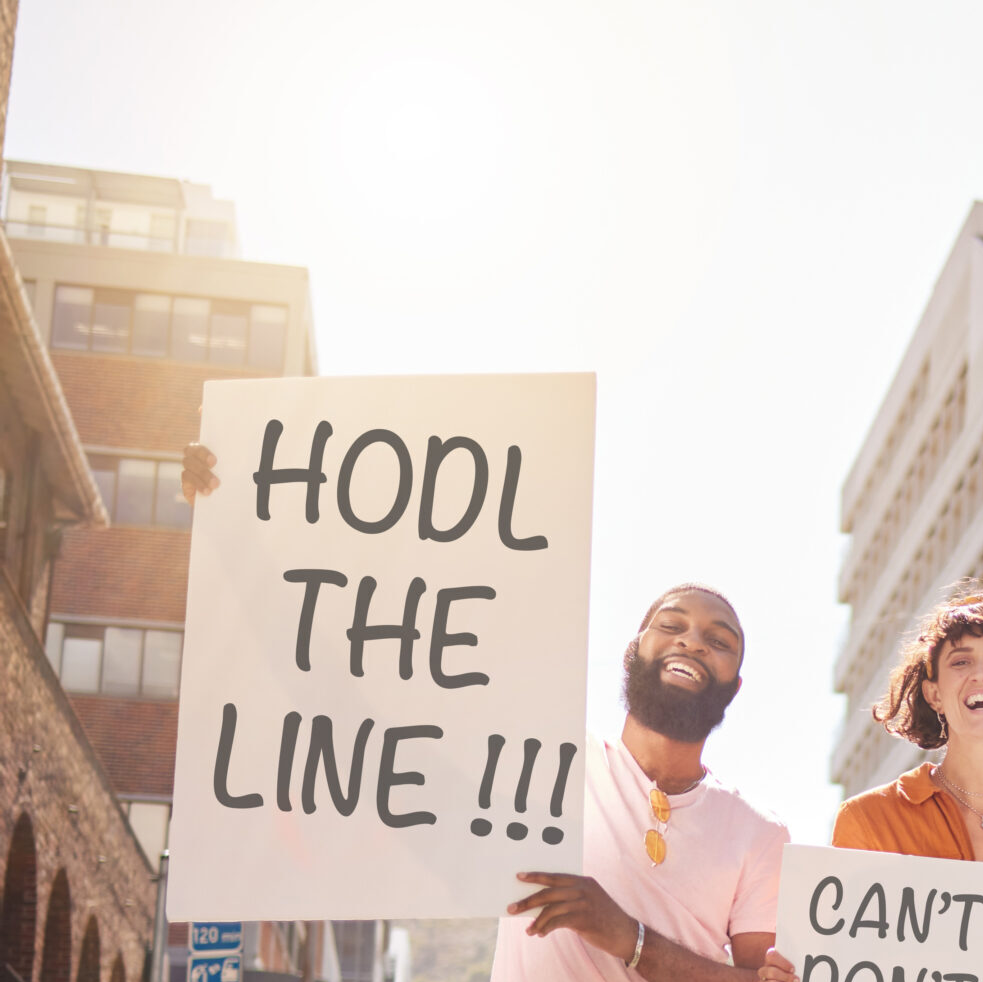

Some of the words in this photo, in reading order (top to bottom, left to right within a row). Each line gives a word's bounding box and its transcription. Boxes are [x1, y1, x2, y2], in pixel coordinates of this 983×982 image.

[252, 419, 549, 551] HODL
[283, 568, 497, 690] THE
[213, 702, 444, 829] LINE
[470, 733, 578, 846] !!!
[194, 926, 219, 945] 120
